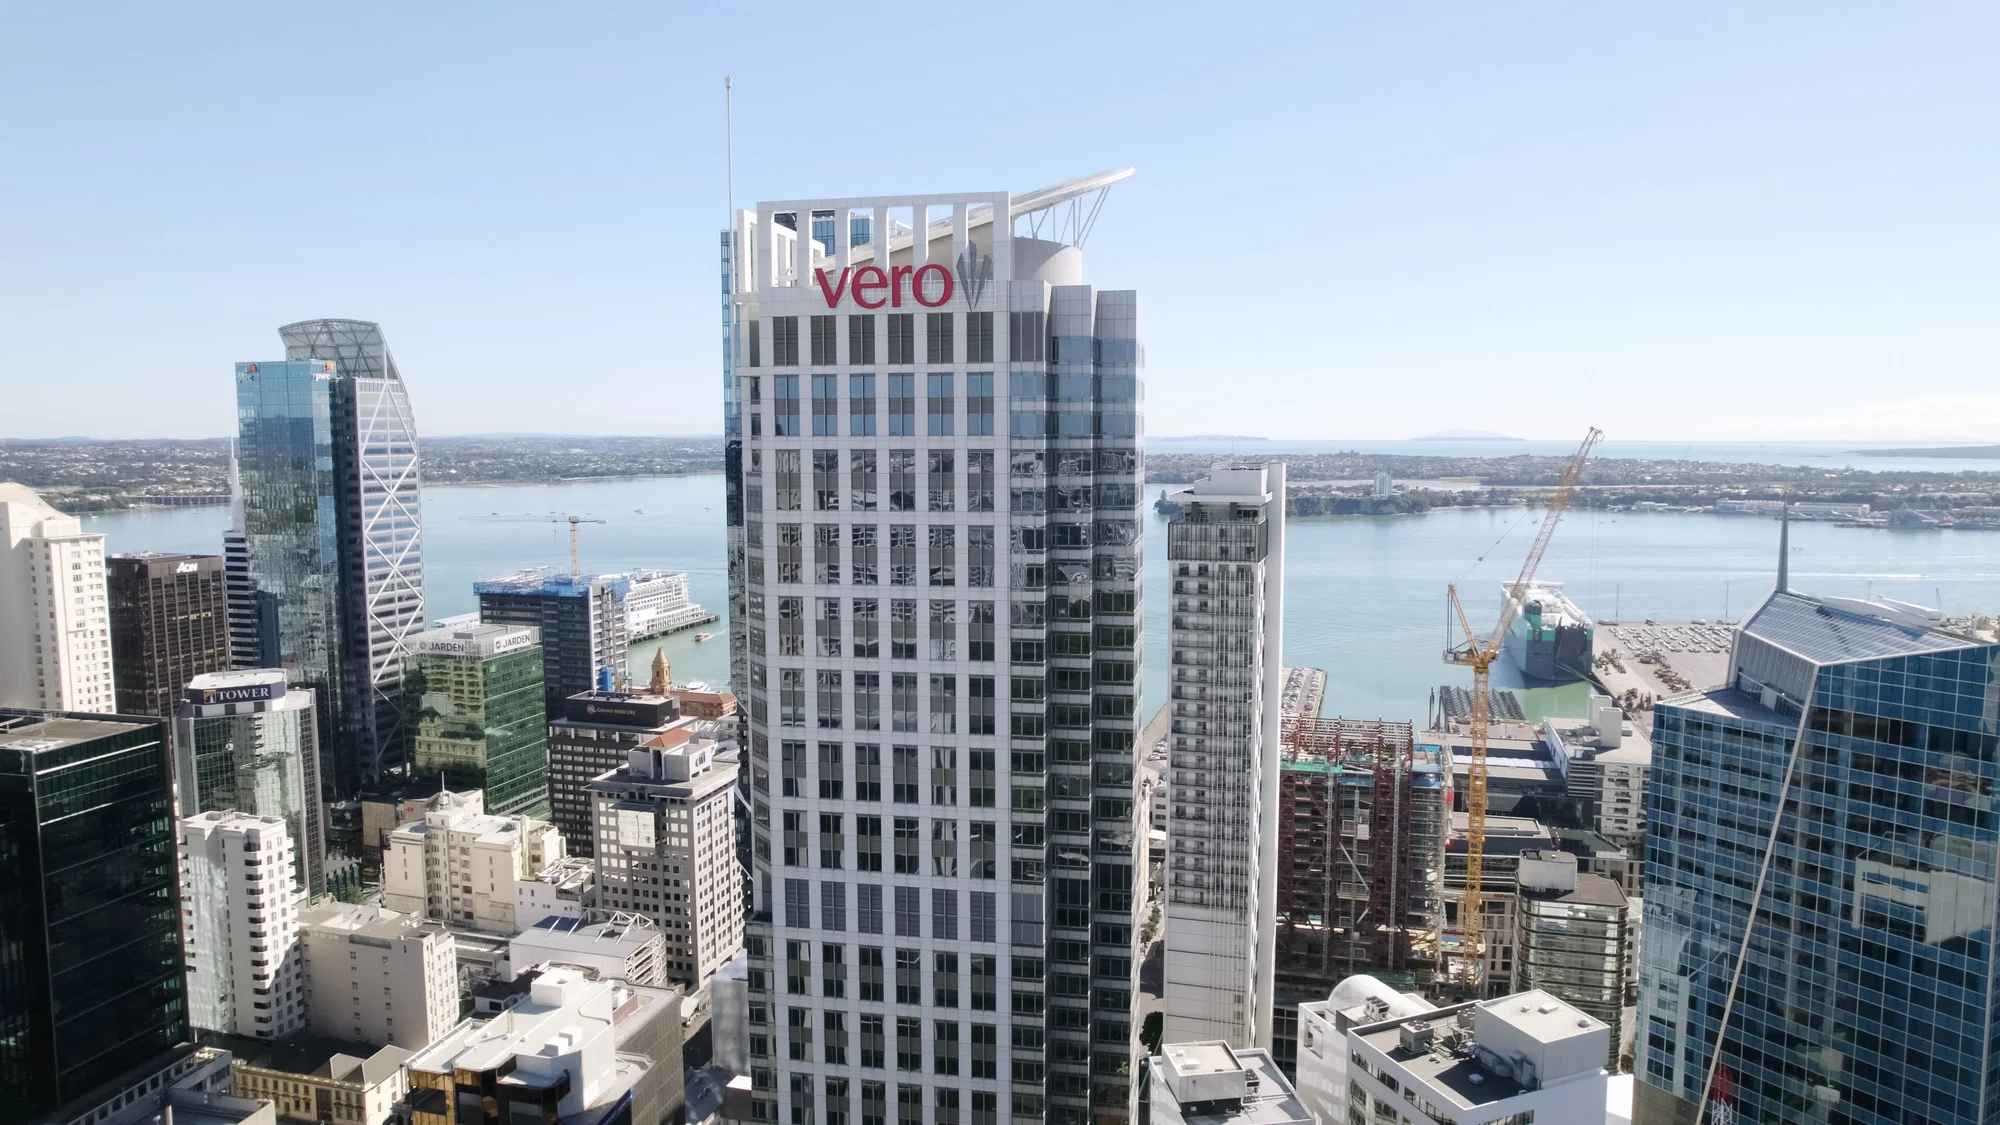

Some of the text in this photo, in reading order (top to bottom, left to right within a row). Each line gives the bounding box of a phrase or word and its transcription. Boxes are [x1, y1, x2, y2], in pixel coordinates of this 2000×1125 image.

[814, 264, 953, 309] vero
[313, 373, 331, 381] pwc
[176, 562, 198, 573] AON
[429, 642, 464, 652] JARDEN
[503, 634, 530, 648] JARDEN
[217, 687, 269, 701] TOWER
